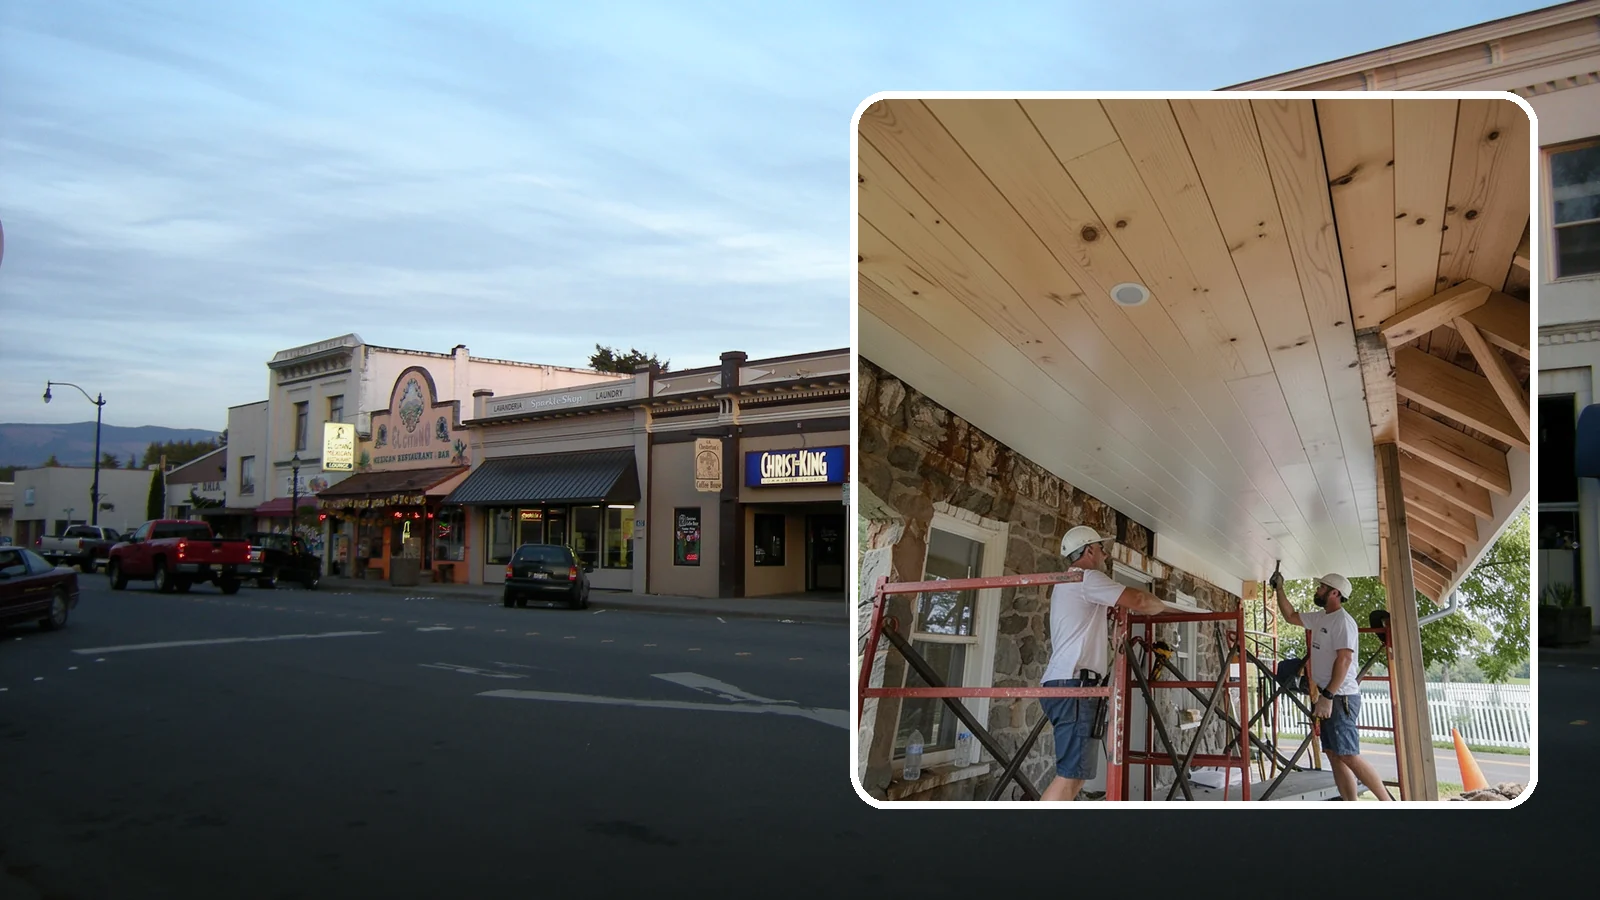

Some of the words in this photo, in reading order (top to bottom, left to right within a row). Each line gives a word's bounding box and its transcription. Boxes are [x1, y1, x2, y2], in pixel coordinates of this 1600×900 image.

[493, 402, 522, 413] LAVANDERIA
[530, 397, 560, 408] Sparkle
[561, 394, 582, 406] Shop
[595, 388, 623, 400] LAUNDRY
[397, 451, 433, 462] RESTAURANT
[438, 450, 450, 459] BAR
[760, 452, 797, 478] CHRIST
[799, 450, 827, 476] KING
